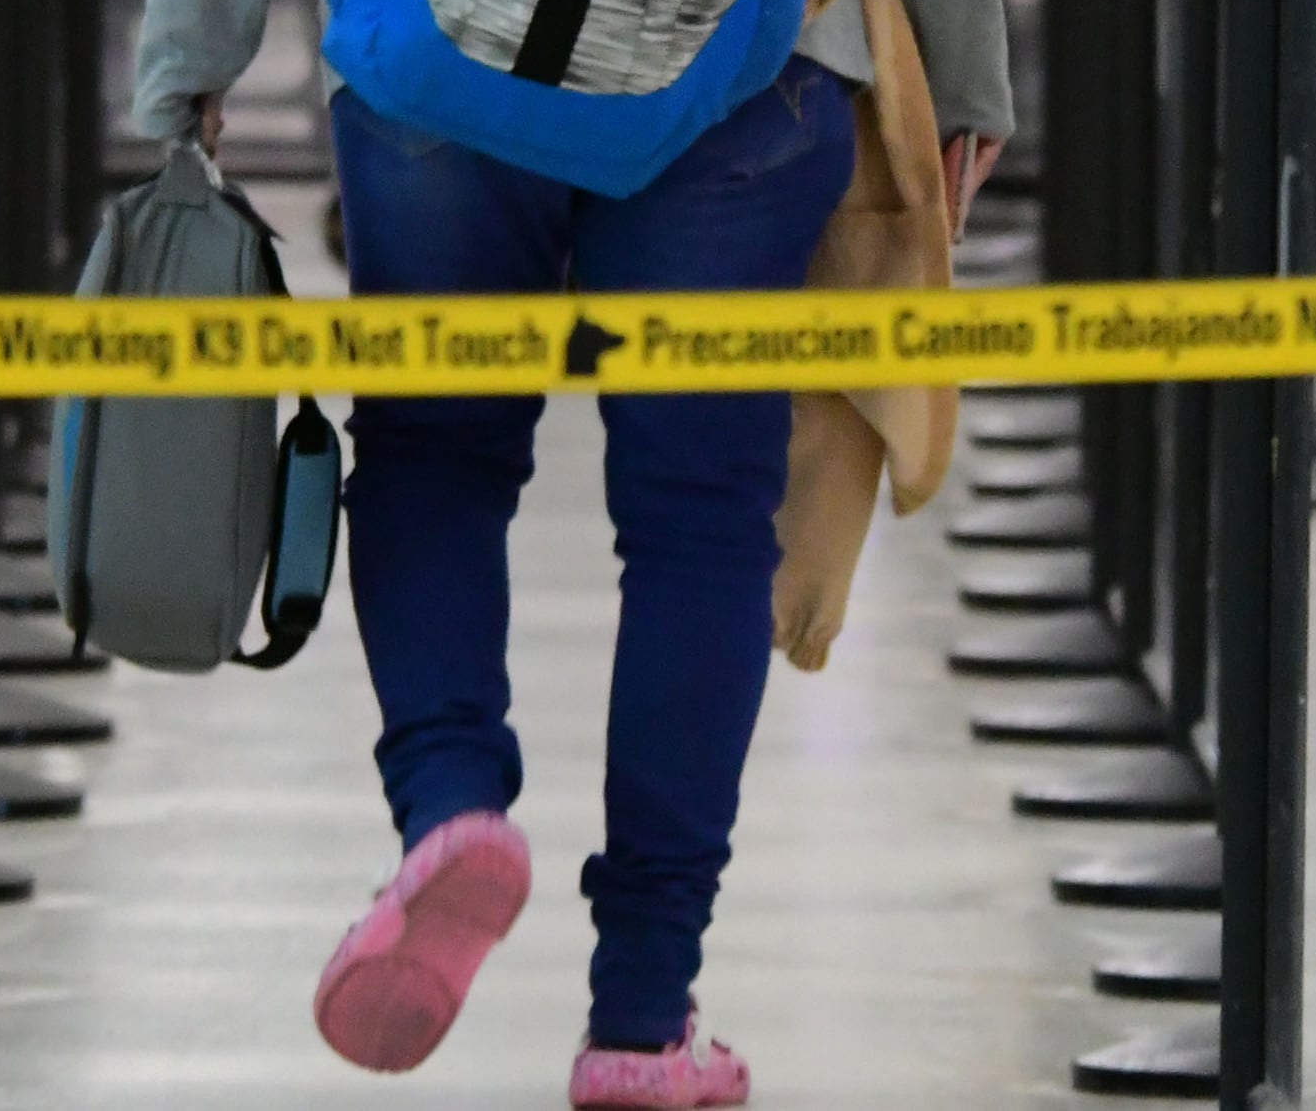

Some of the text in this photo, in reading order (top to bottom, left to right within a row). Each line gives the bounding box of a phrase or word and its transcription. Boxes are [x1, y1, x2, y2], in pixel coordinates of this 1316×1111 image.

[190, 317, 243, 367] K9
[257, 316, 314, 367] Do
[329, 317, 405, 367] Not
[419, 314, 551, 367] Touch
[640, 309, 879, 367] Precaucion
[892, 303, 1036, 360] Canino
[1051, 294, 1282, 363] Trabajando
